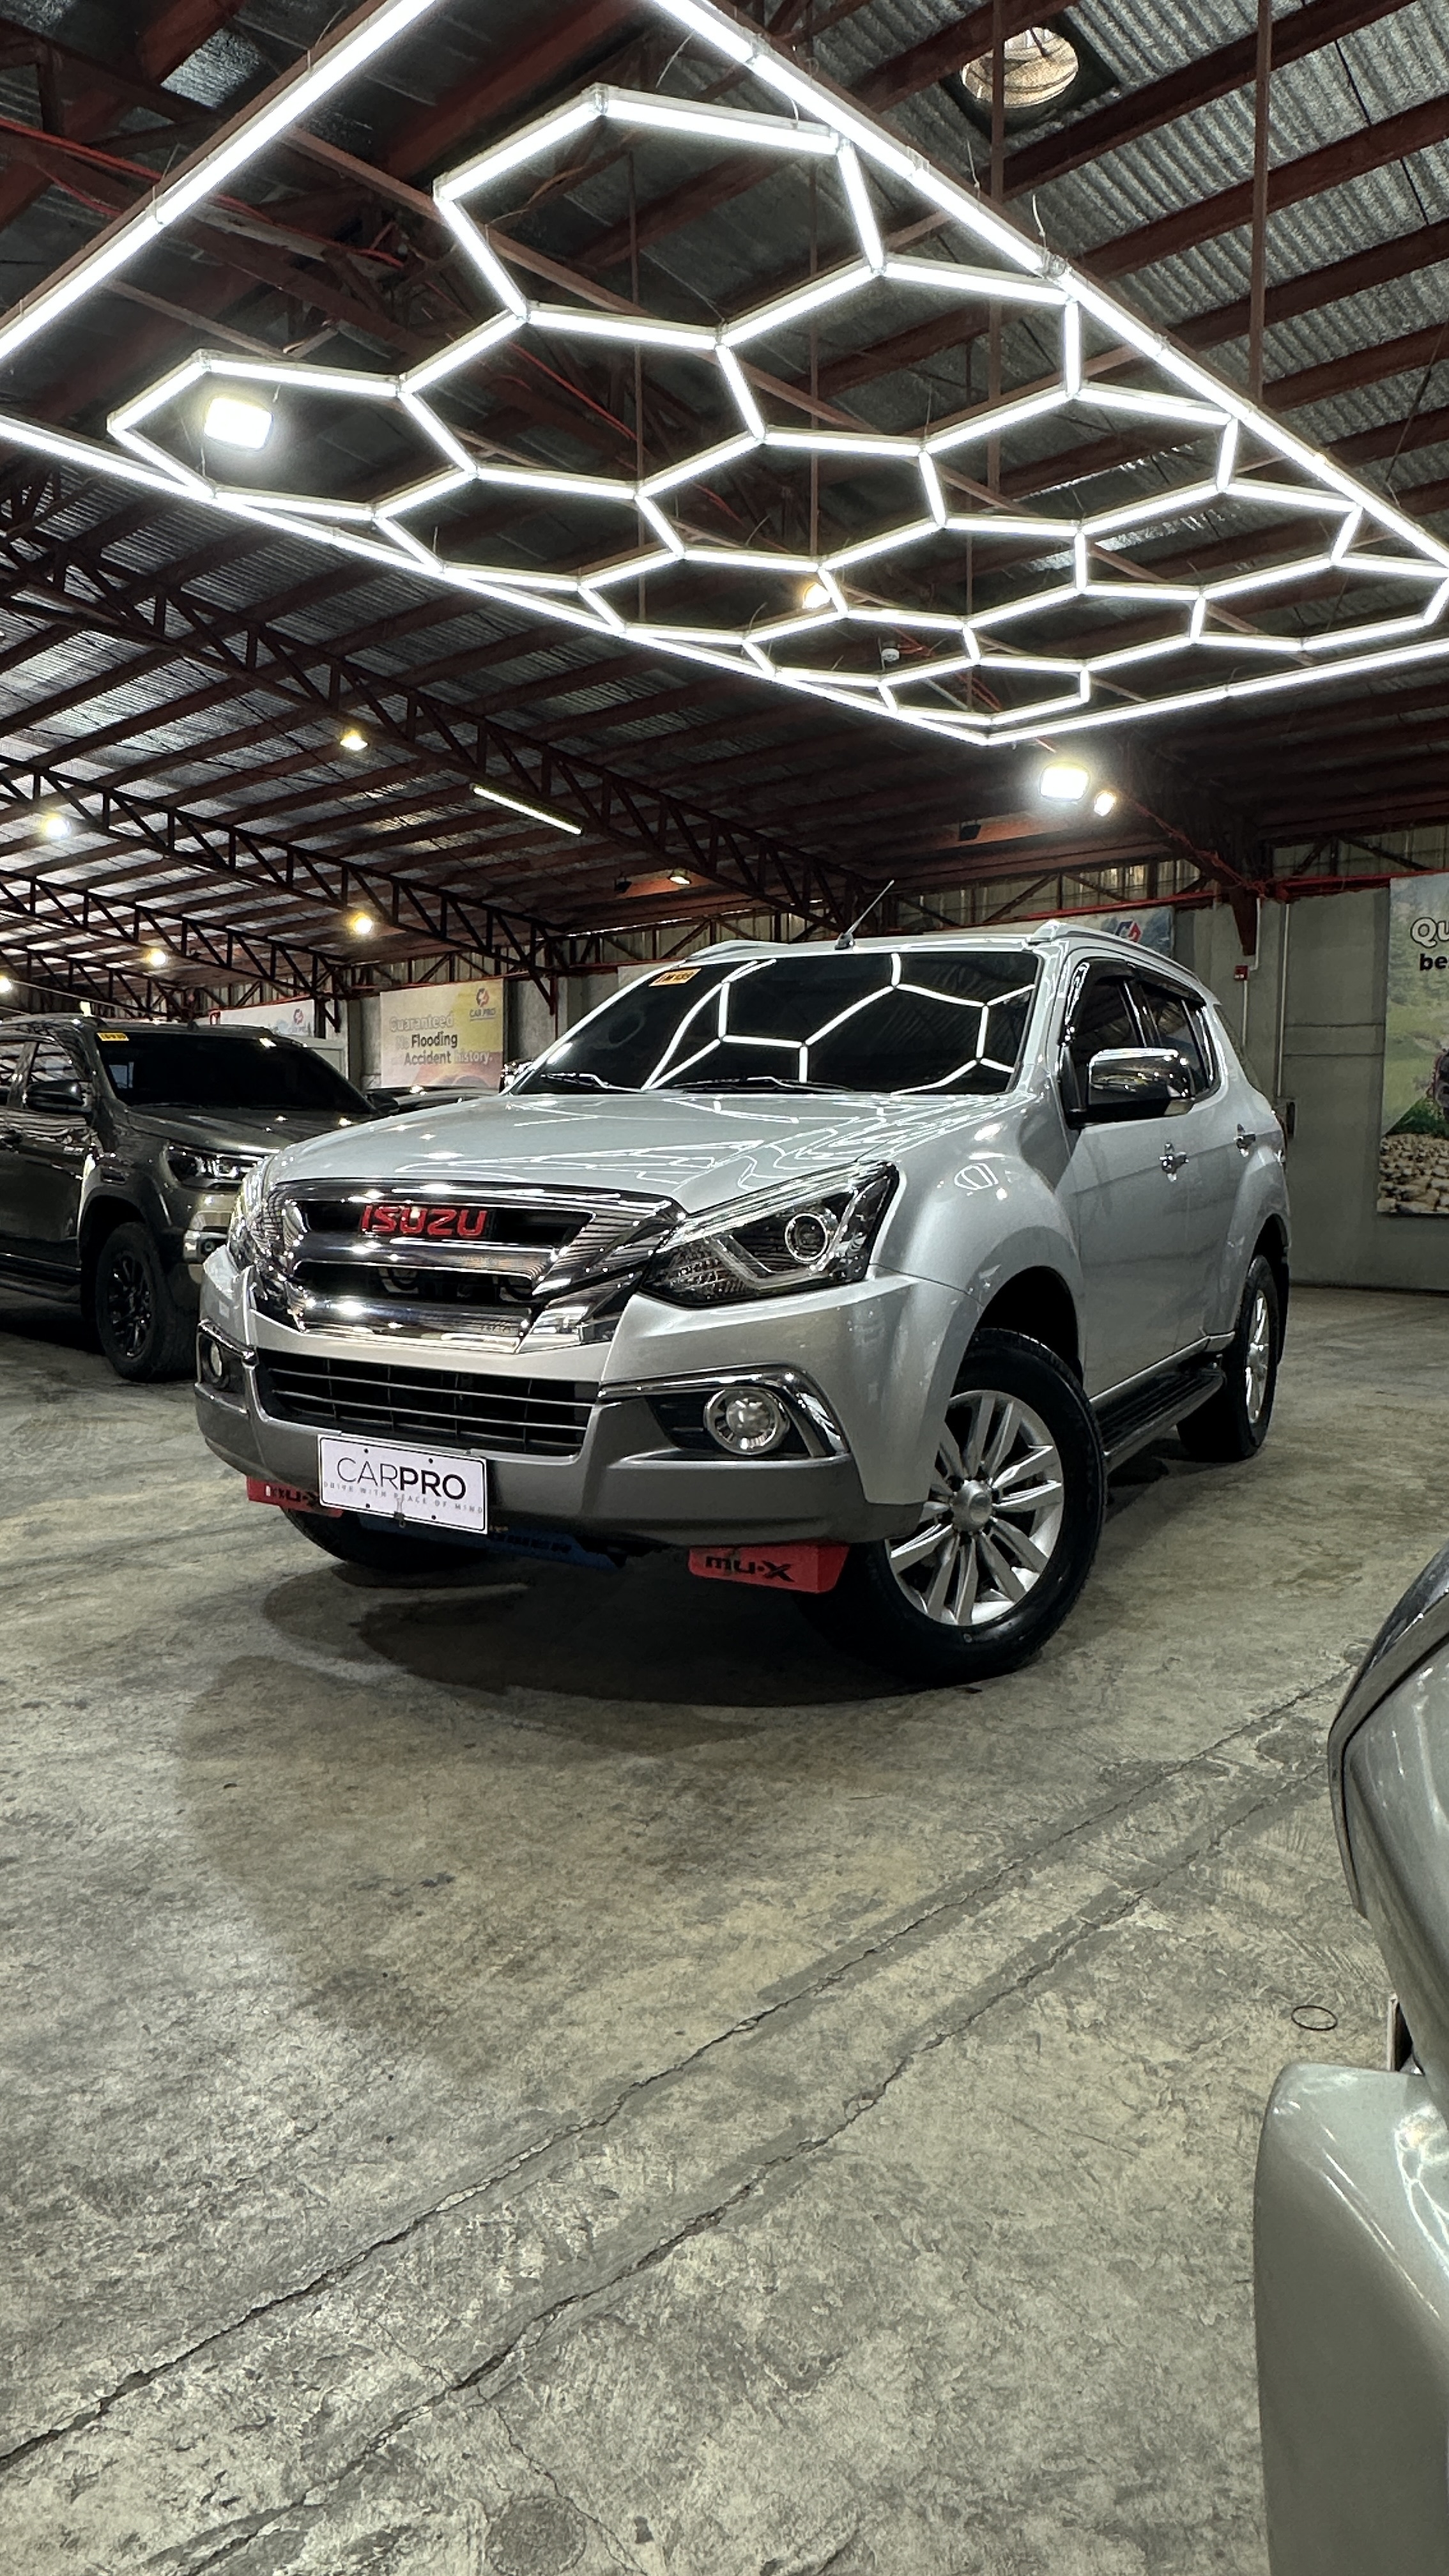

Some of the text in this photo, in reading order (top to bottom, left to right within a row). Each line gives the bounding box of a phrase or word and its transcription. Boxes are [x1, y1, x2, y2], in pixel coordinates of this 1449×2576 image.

[1420, 954, 1449, 970] be
[389, 1011, 454, 1032] Guaranteed
[411, 1031, 457, 1048] Flooding
[404, 1050, 451, 1066] Accident
[361, 1205, 487, 1236] ISUZU
[337, 1457, 466, 1500] CARPRO
[434, 1499, 447, 1507] OF
